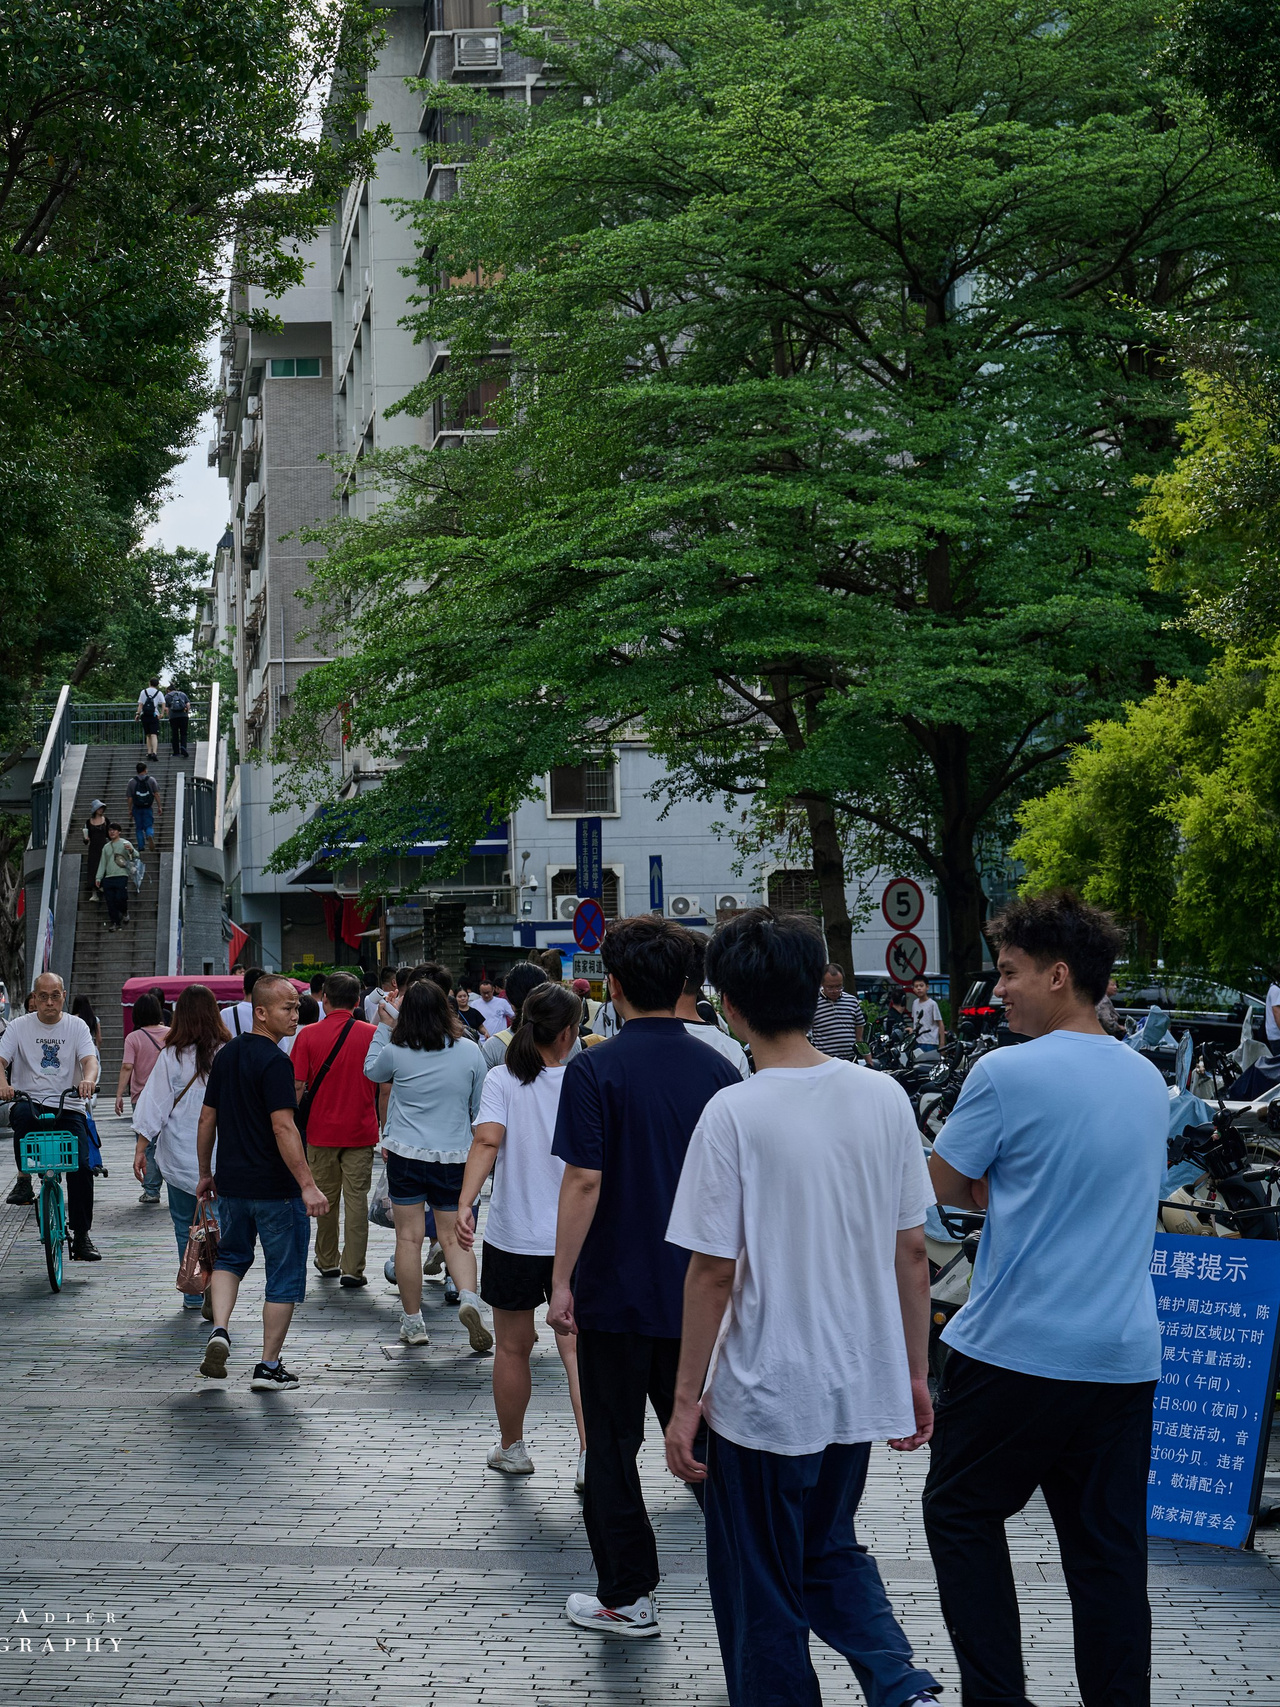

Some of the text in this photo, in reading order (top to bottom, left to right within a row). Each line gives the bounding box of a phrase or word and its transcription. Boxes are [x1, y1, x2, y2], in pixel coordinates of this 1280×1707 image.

[897, 891, 911, 917] 5
[1150, 1249, 1249, 1283] 温馨提示
[1162, 1346, 1252, 1369] 展大音量活动：
[1150, 1504, 1237, 1531] 陈家祠管委会
